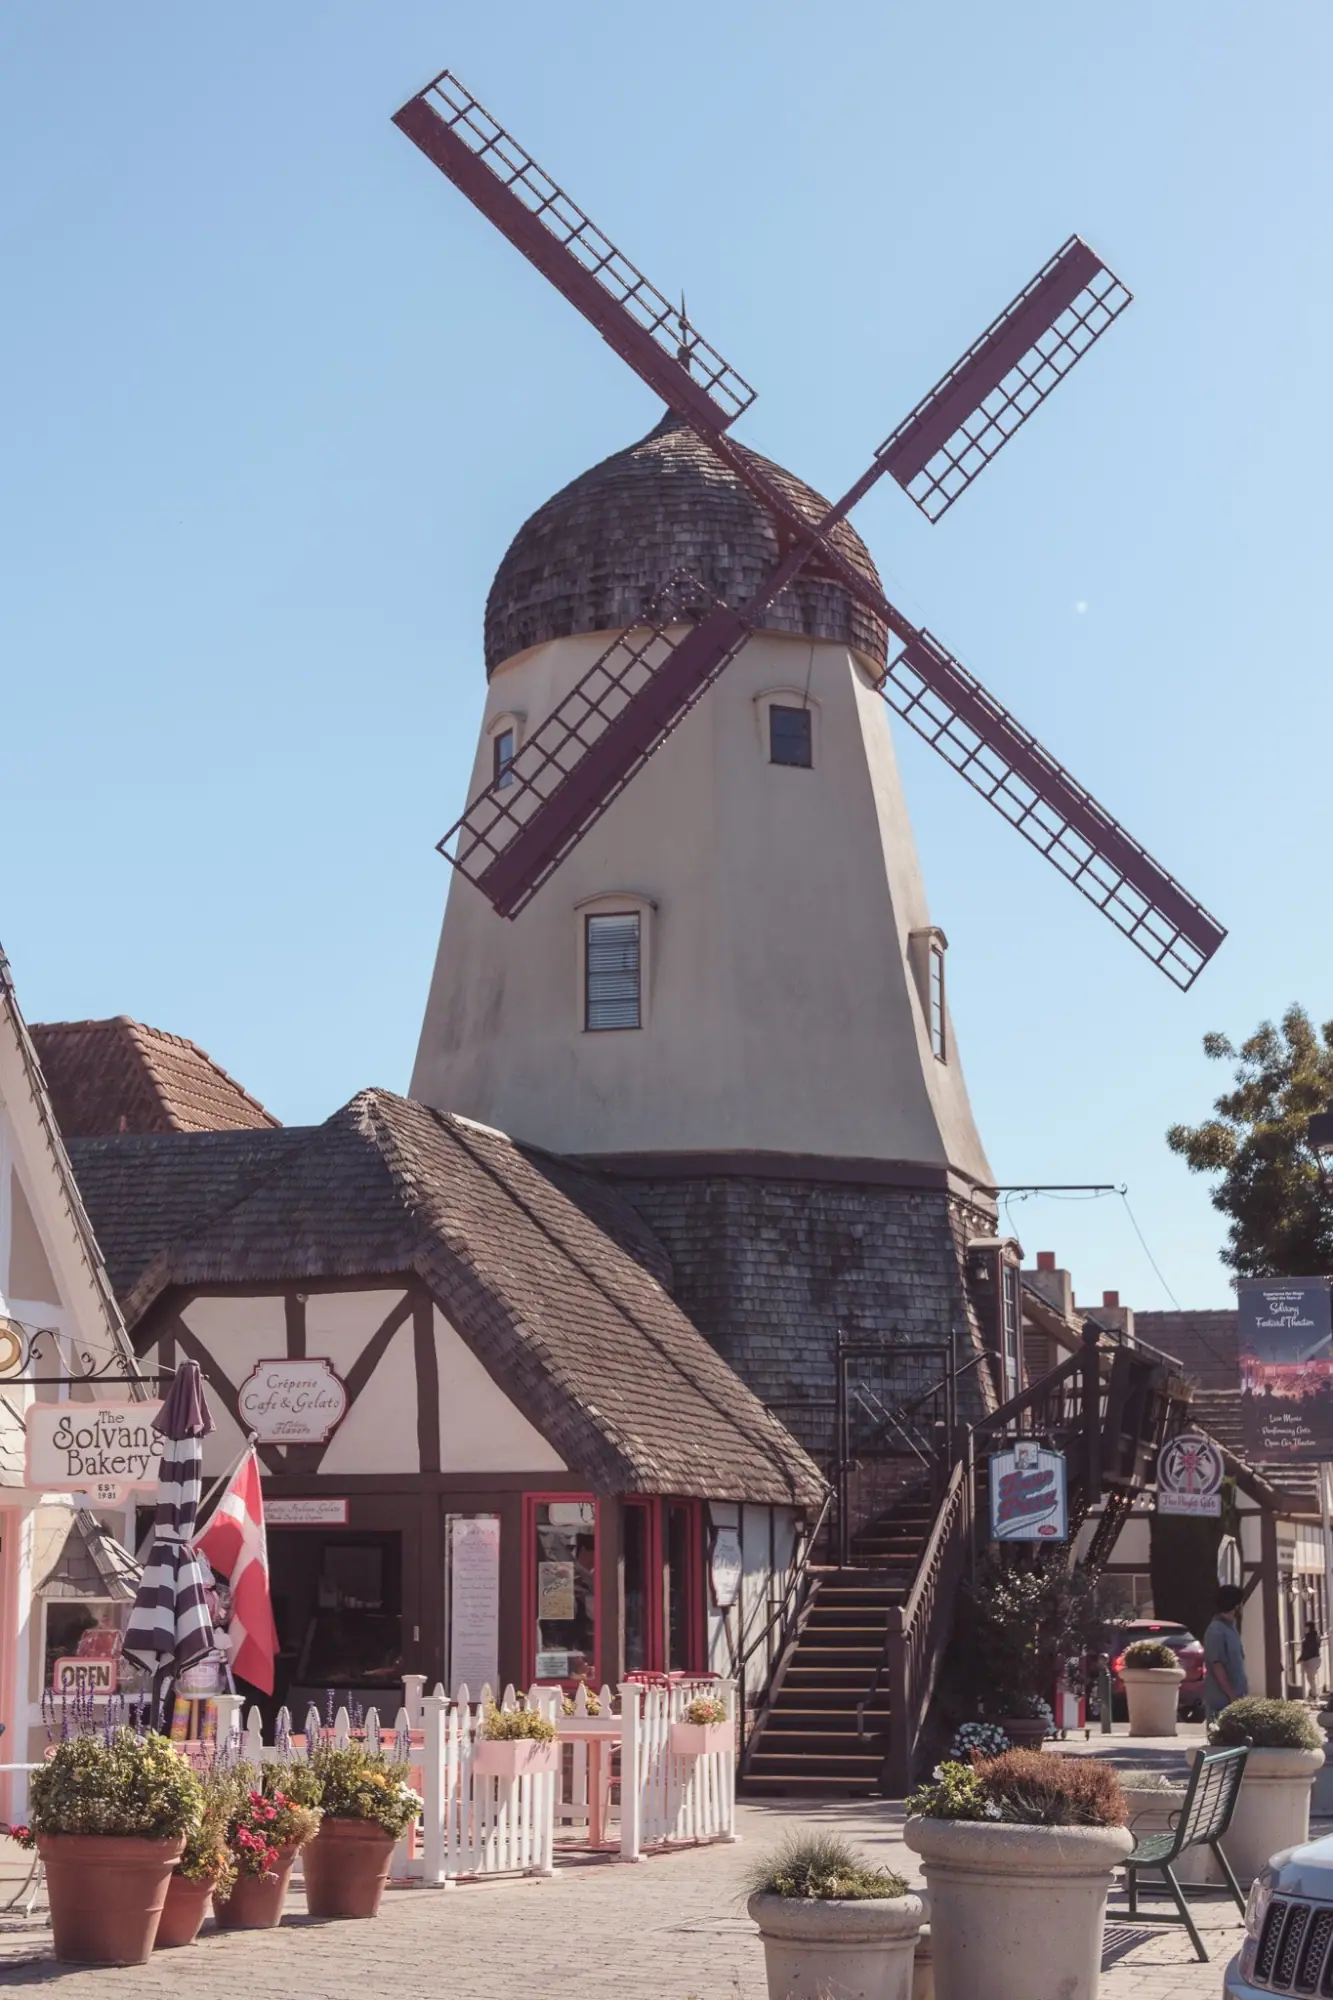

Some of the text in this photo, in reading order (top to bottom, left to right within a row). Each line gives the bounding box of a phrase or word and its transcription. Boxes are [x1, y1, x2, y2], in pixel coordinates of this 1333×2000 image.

[1269, 1302, 1300, 1316] Solvang
[280, 1397, 291, 1408] &
[291, 1389, 340, 1413] Gelato
[99, 1410, 125, 1424] The
[52, 1416, 165, 1457] Solvang
[66, 1449, 152, 1480] Bakery
[98, 1483, 116, 1491] EST
[61, 1665, 110, 1687] OPEN
